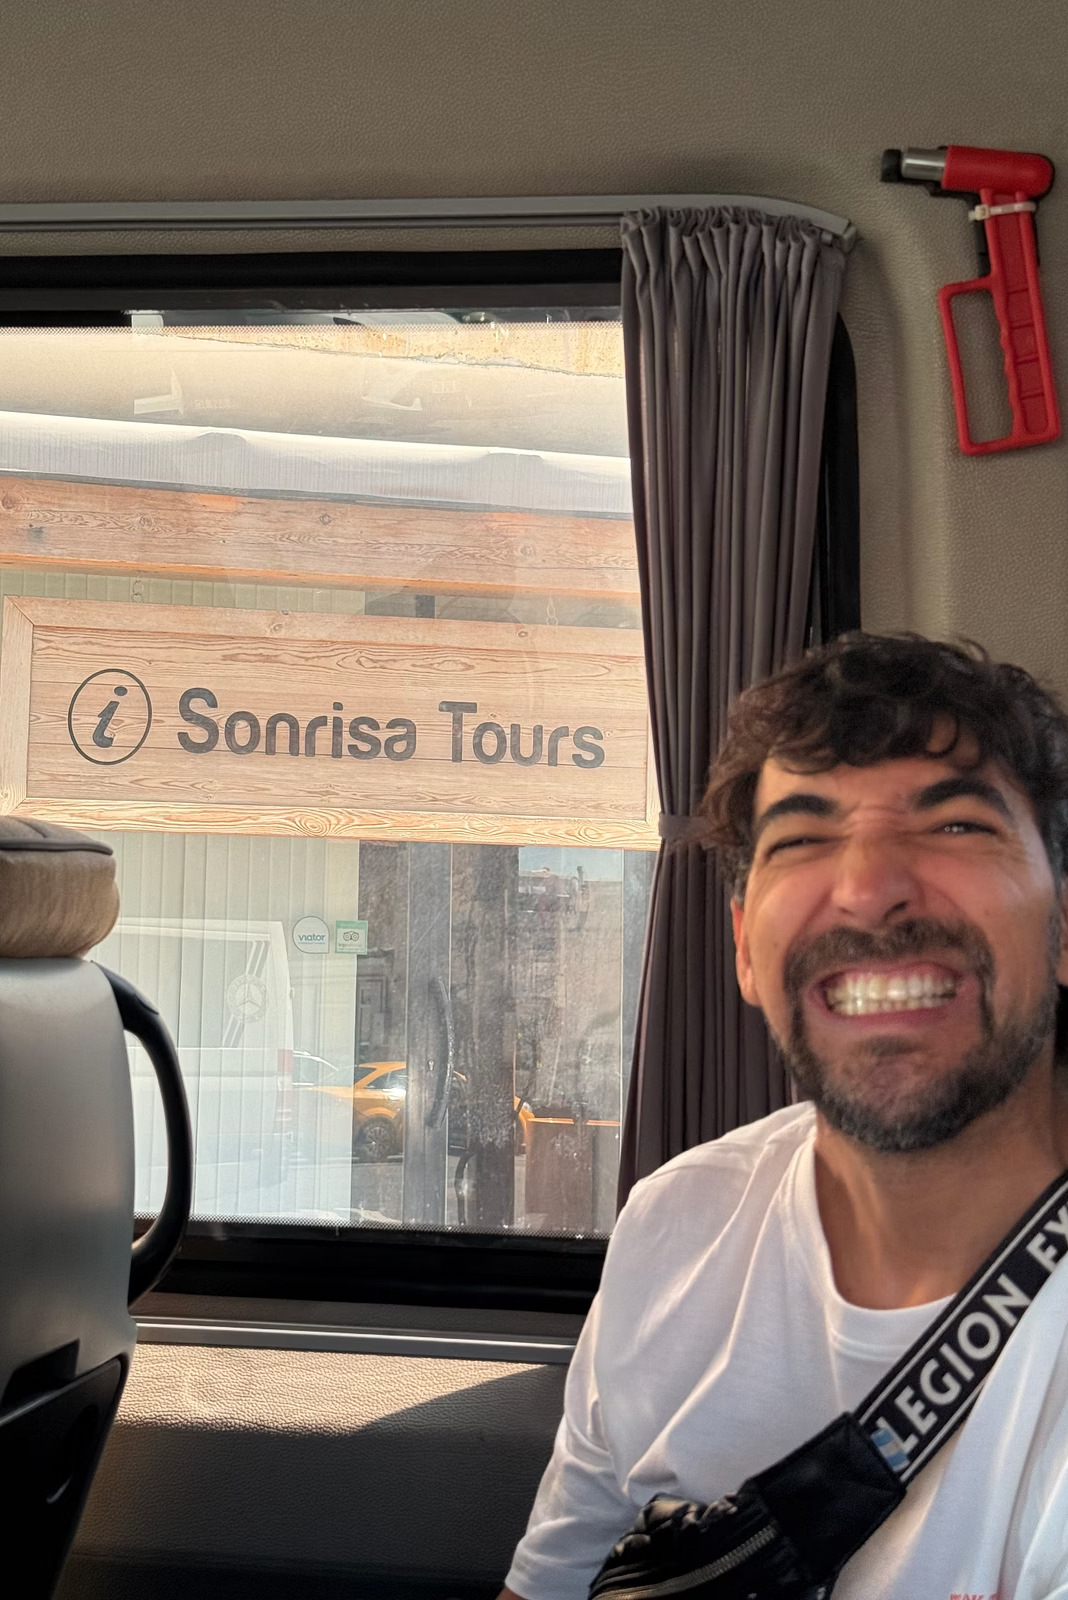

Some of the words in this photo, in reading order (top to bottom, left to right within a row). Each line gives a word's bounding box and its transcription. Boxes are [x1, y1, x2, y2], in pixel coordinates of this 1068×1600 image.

[177, 687, 417, 762] Sonrisa
[438, 701, 605, 769] Tours
[298, 933, 326, 942] viator
[875, 1273, 1033, 1454] LEGION
